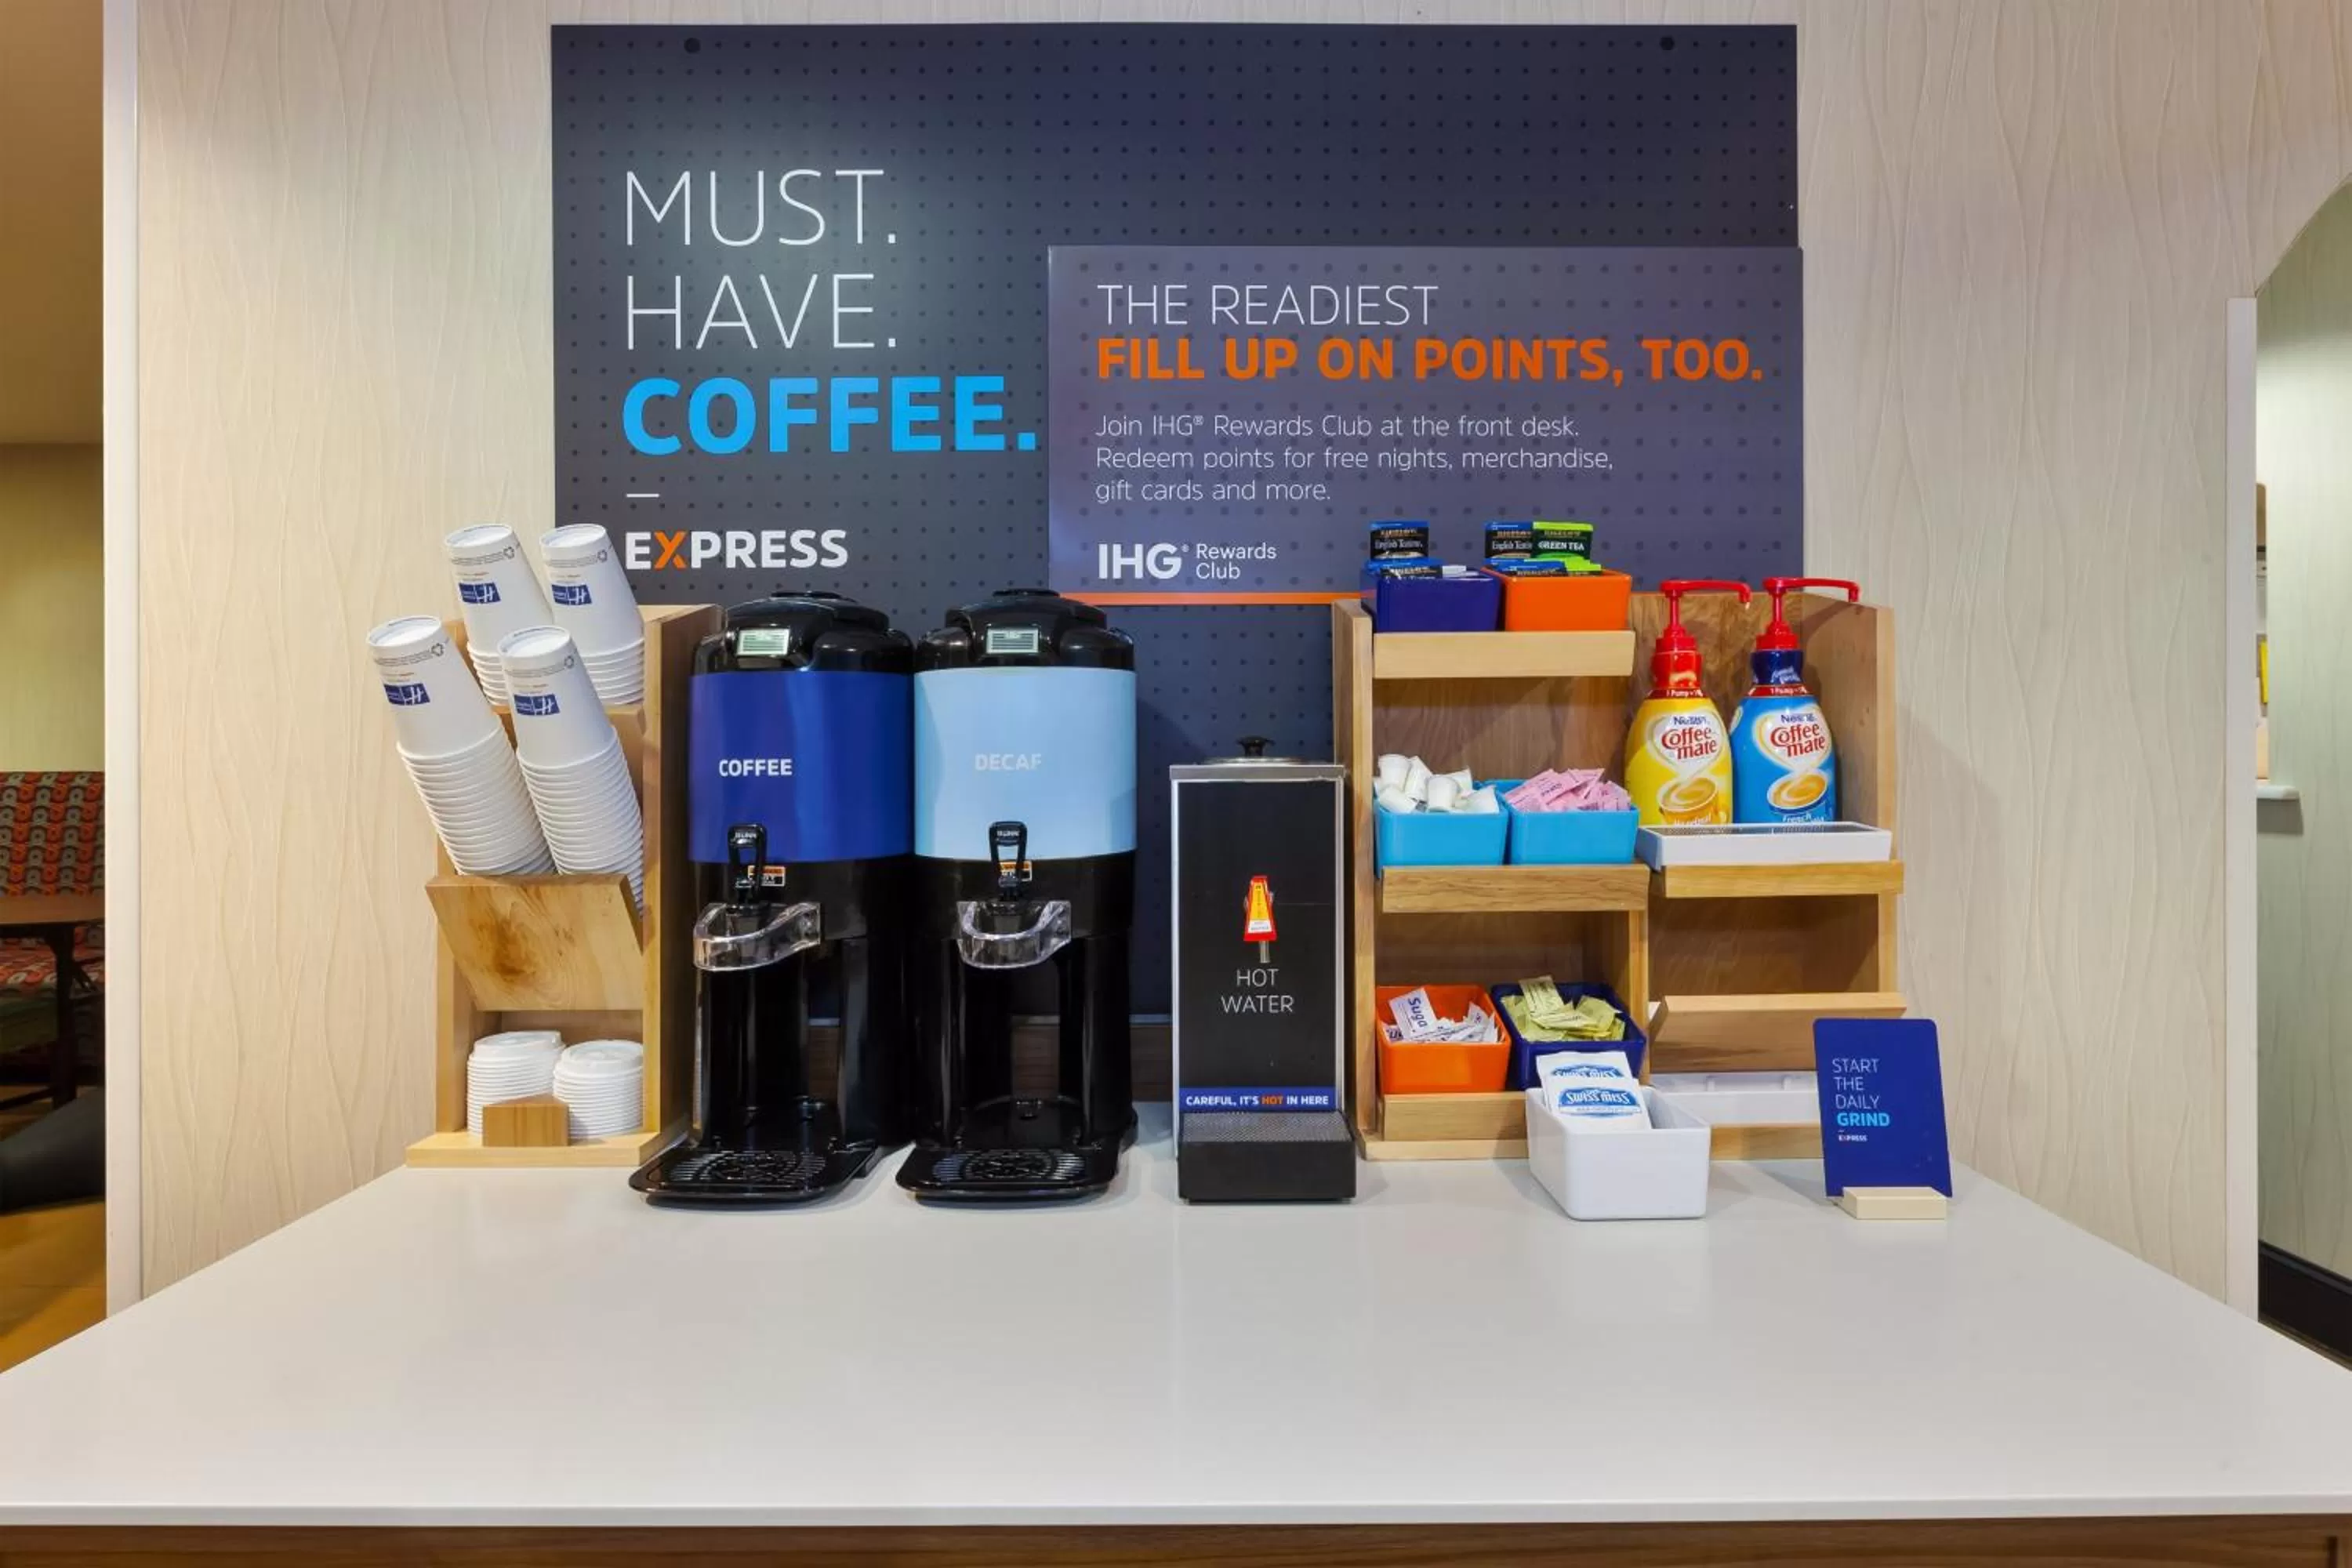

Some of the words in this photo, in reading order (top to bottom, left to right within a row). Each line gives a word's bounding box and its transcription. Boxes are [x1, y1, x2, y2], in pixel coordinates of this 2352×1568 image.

[627, 169, 896, 246] MUST.
[627, 274, 896, 350] HAVE.
[1098, 285, 1188, 325] THE
[1211, 285, 1439, 325] READIEST
[1098, 338, 1205, 379] FILL
[1225, 338, 1298, 380] UP
[1317, 337, 1393, 381] ON
[1414, 338, 1624, 387] POINTS,
[1641, 338, 1763, 381] TOO.
[622, 376, 1036, 456] COFFEE.
[1095, 415, 1142, 437] Join
[1214, 415, 1312, 437] Rewards
[1322, 415, 1372, 437] Club
[1380, 417, 1403, 437] at
[1412, 415, 1450, 437] the
[1457, 414, 1513, 437] front
[1522, 414, 1579, 437] desk.
[1097, 447, 1193, 469] Redeem
[1203, 447, 1274, 471] points
[1283, 447, 1315, 469] for
[1323, 447, 1369, 469] free
[1378, 447, 1453, 471] nights,
[1462, 447, 1613, 472] merchandise,
[1095, 479, 1133, 504] gift
[1141, 479, 1203, 500] cards
[1213, 479, 1255, 500] and
[1266, 482, 1331, 500] more.
[626, 530, 848, 569] EXPRESS
[1196, 543, 1277, 559] Rewards
[1537, 541, 1567, 550] GREEN
[1569, 541, 1585, 550] TEA
[1196, 562, 1241, 579] Club
[1661, 728, 1712, 750] Coffee
[1770, 724, 1820, 749] Coffee
[1787, 735, 1826, 757] mate
[1678, 739, 1717, 760] mate
[718, 758, 793, 777] COFFEE
[975, 753, 1043, 771] DECAF
[1236, 969, 1279, 986] HOT
[1221, 995, 1294, 1013] WATER
[1831, 1058, 1879, 1073] START
[1833, 1076, 1864, 1091] THE
[1186, 1096, 1236, 1106] CAREFUL,
[1240, 1096, 1259, 1105] IT'S
[1261, 1096, 1283, 1105] HOT
[1287, 1096, 1298, 1105] IN
[1301, 1096, 1329, 1105] HERE
[1835, 1094, 1879, 1109] DAILY
[1837, 1112, 1890, 1127] GRIND
